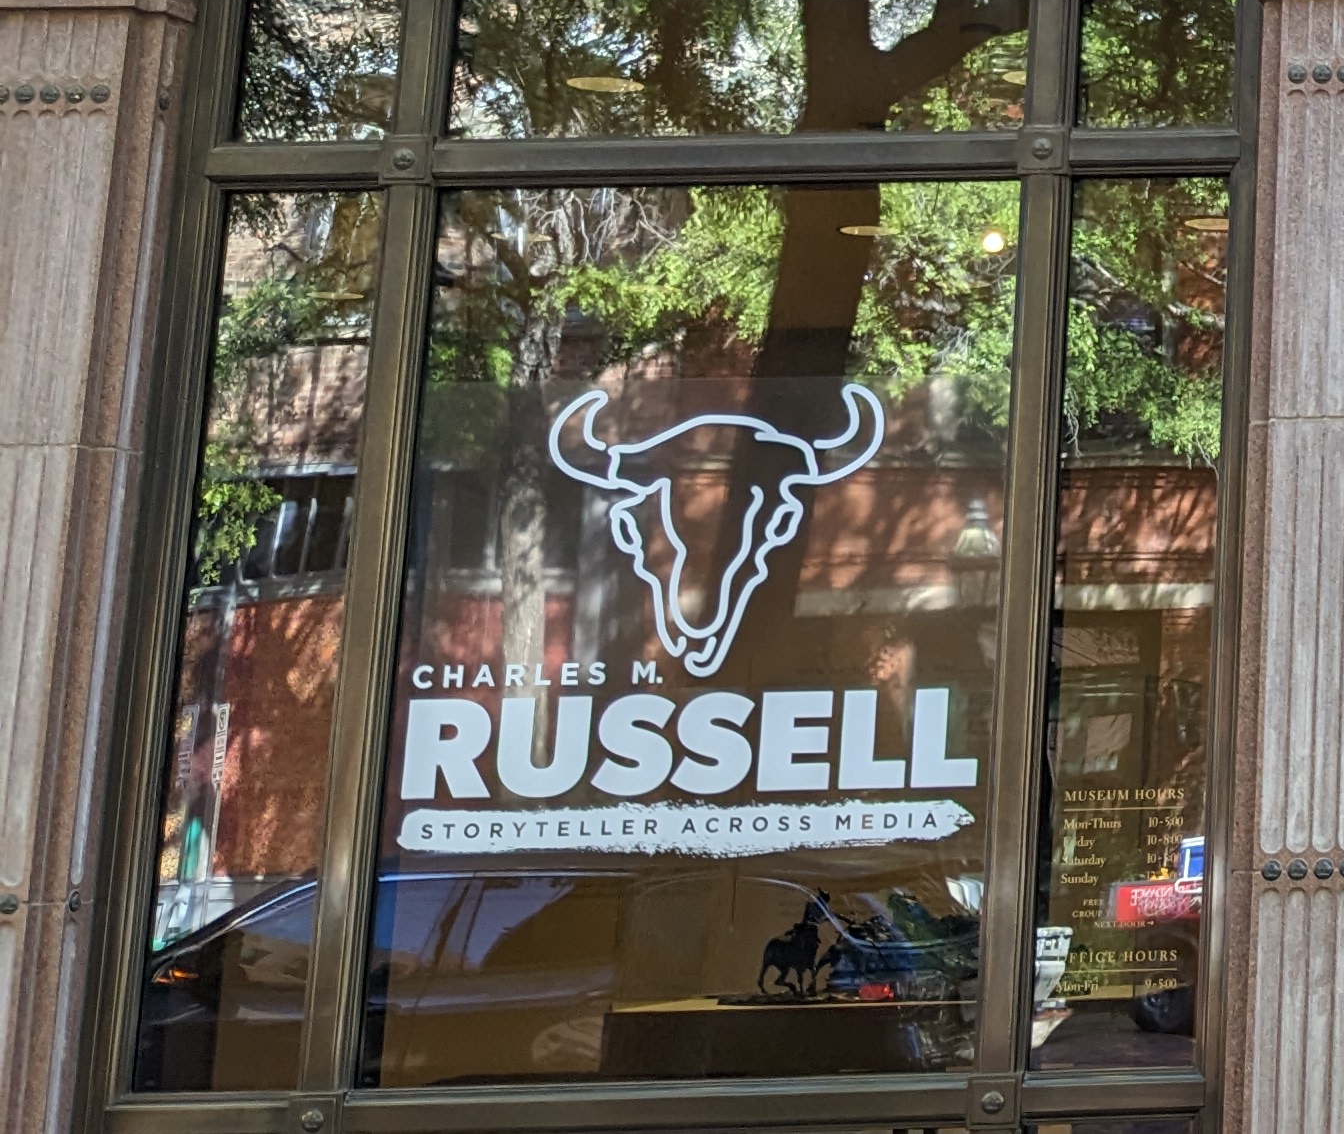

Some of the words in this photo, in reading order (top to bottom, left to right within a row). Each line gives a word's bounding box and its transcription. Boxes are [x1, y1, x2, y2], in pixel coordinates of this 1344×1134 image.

[412, 662, 606, 690] CHARLES
[631, 660, 663, 685] M.
[401, 688, 978, 800] RUSSELL
[1064, 789, 1129, 802] MUSEUM
[1135, 787, 1185, 800] HOURS
[420, 818, 659, 841] STORYTELLER
[681, 814, 811, 836] ACROSS
[835, 812, 938, 832] MEDIA
[1063, 817, 1122, 830] Mon-Thurs
[1064, 834, 1096, 849] Fday
[1060, 871, 1099, 885] Sunday
[1123, 949, 1178, 962] HOURS
